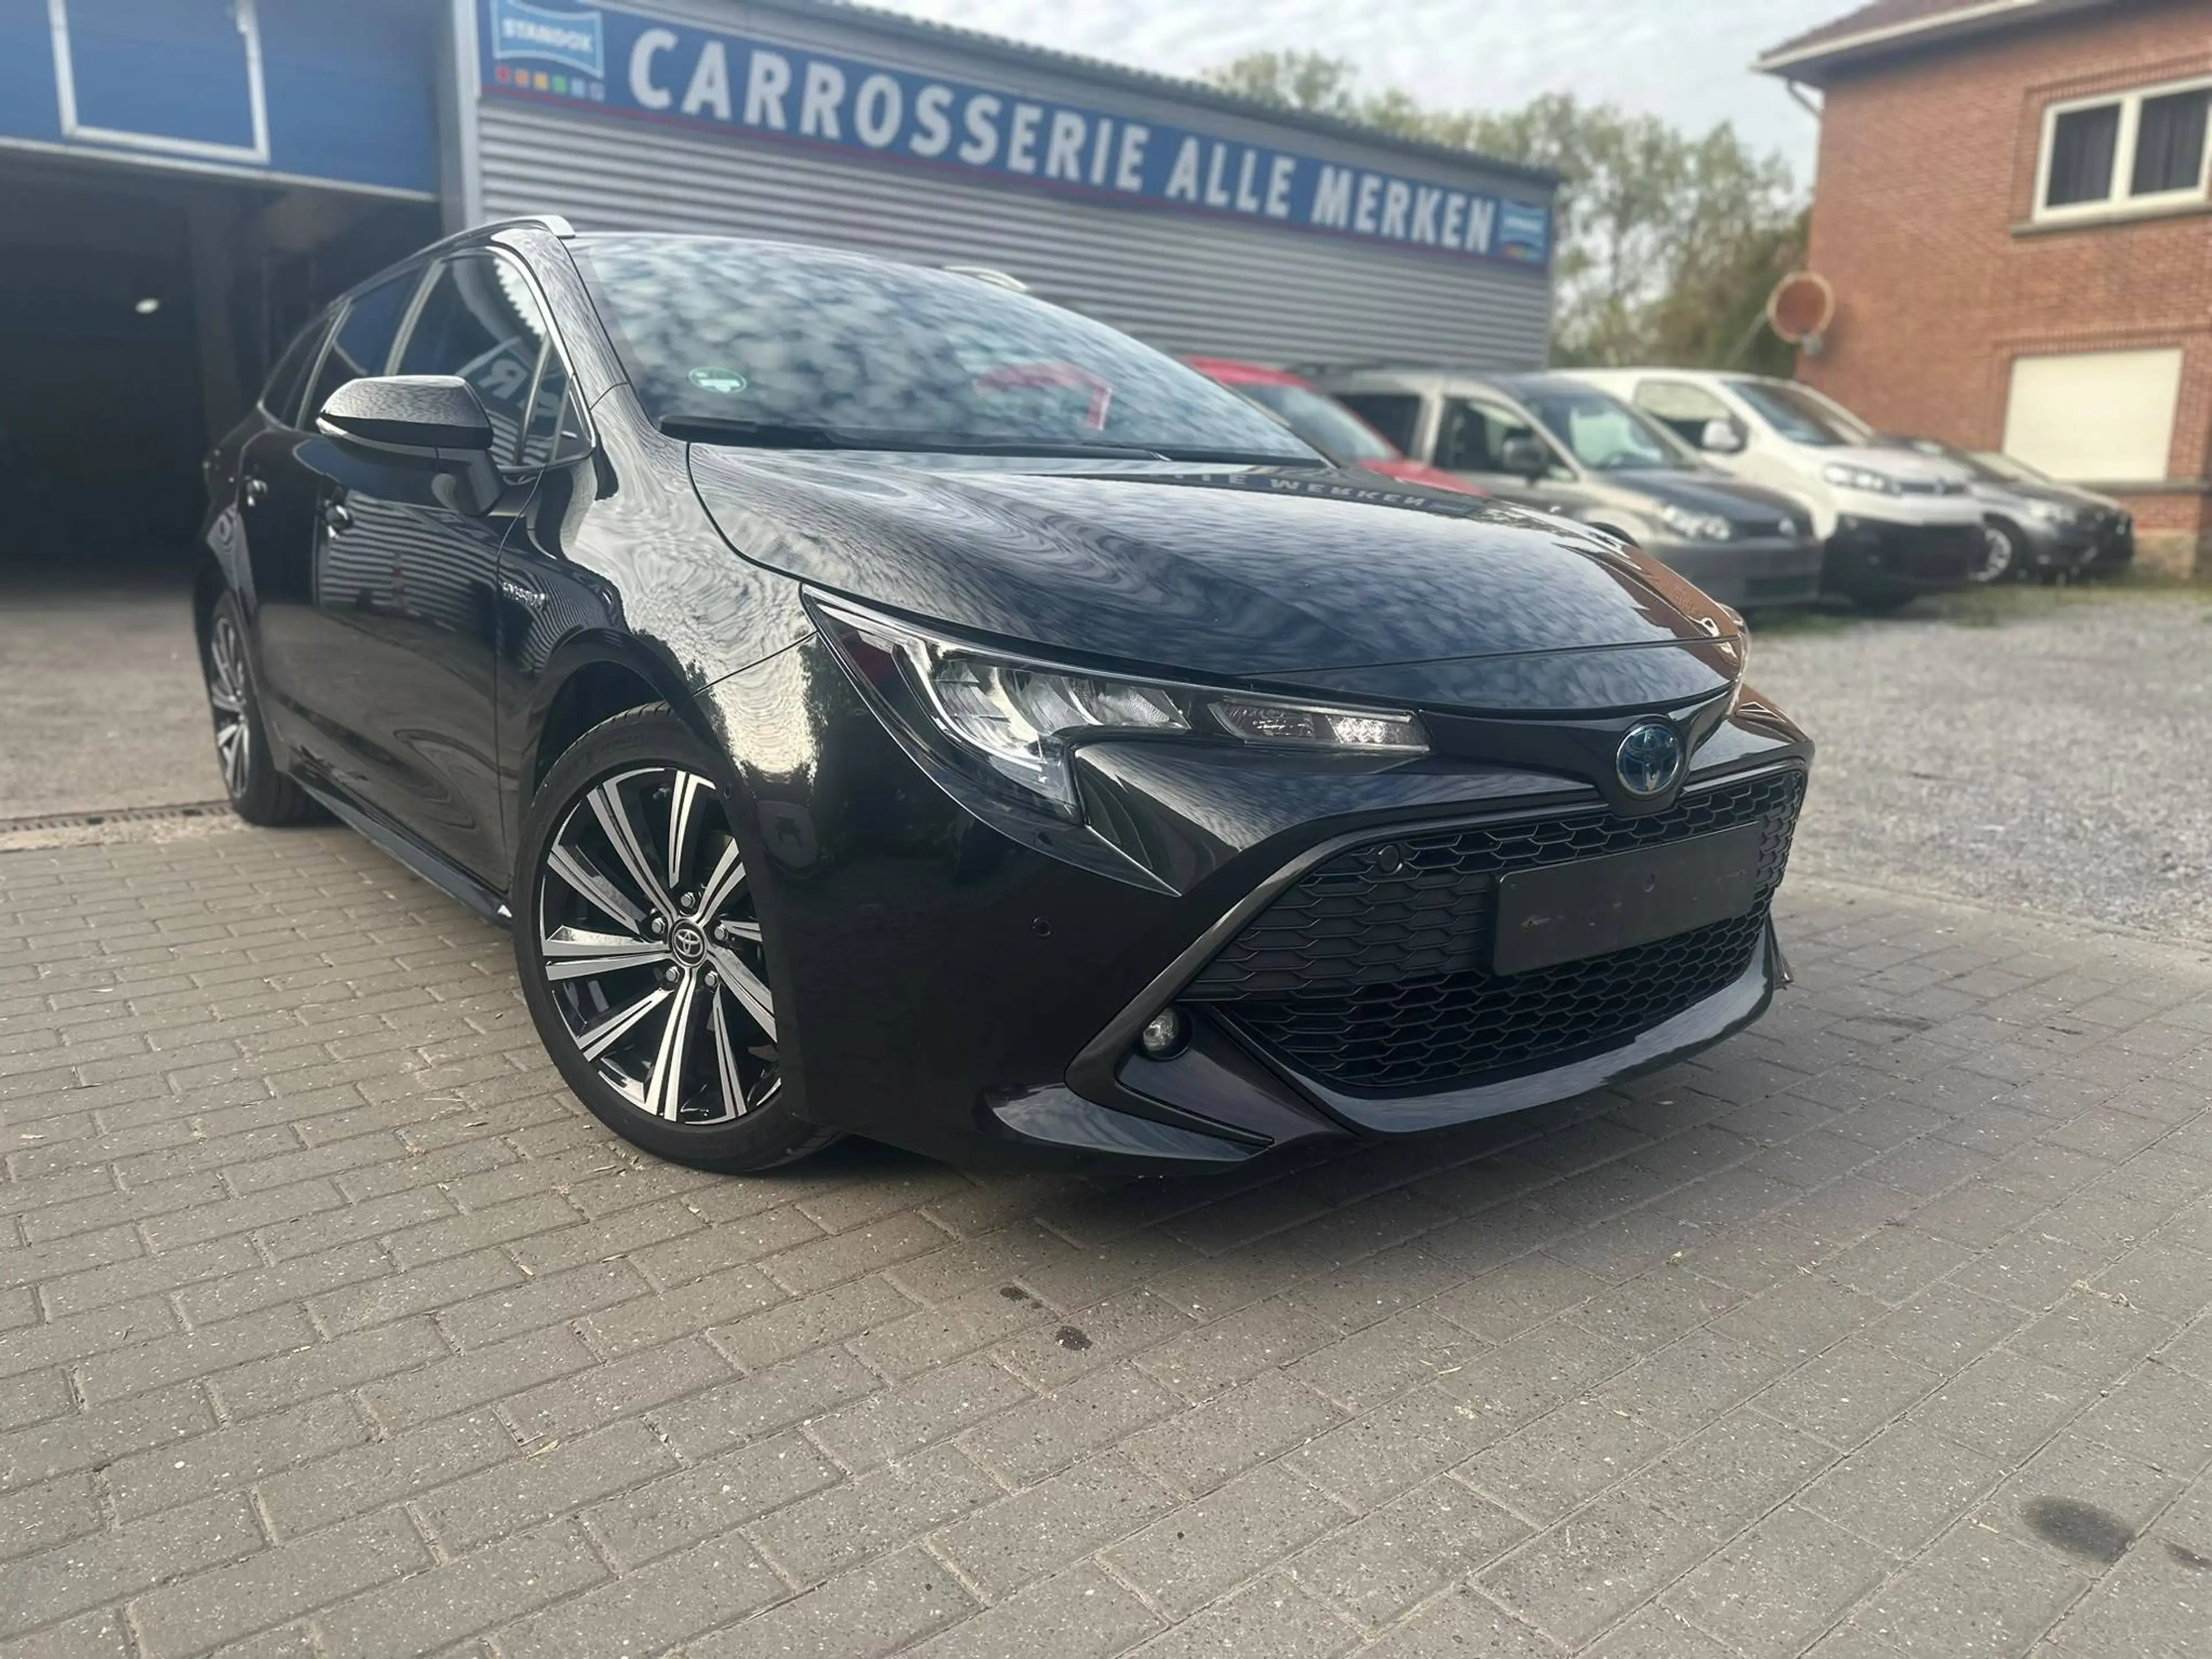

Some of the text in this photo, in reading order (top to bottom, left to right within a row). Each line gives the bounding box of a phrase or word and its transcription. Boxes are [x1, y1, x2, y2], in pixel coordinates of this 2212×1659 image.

[628, 28, 1495, 254] CARROSSERIE ALLE MERKEN
